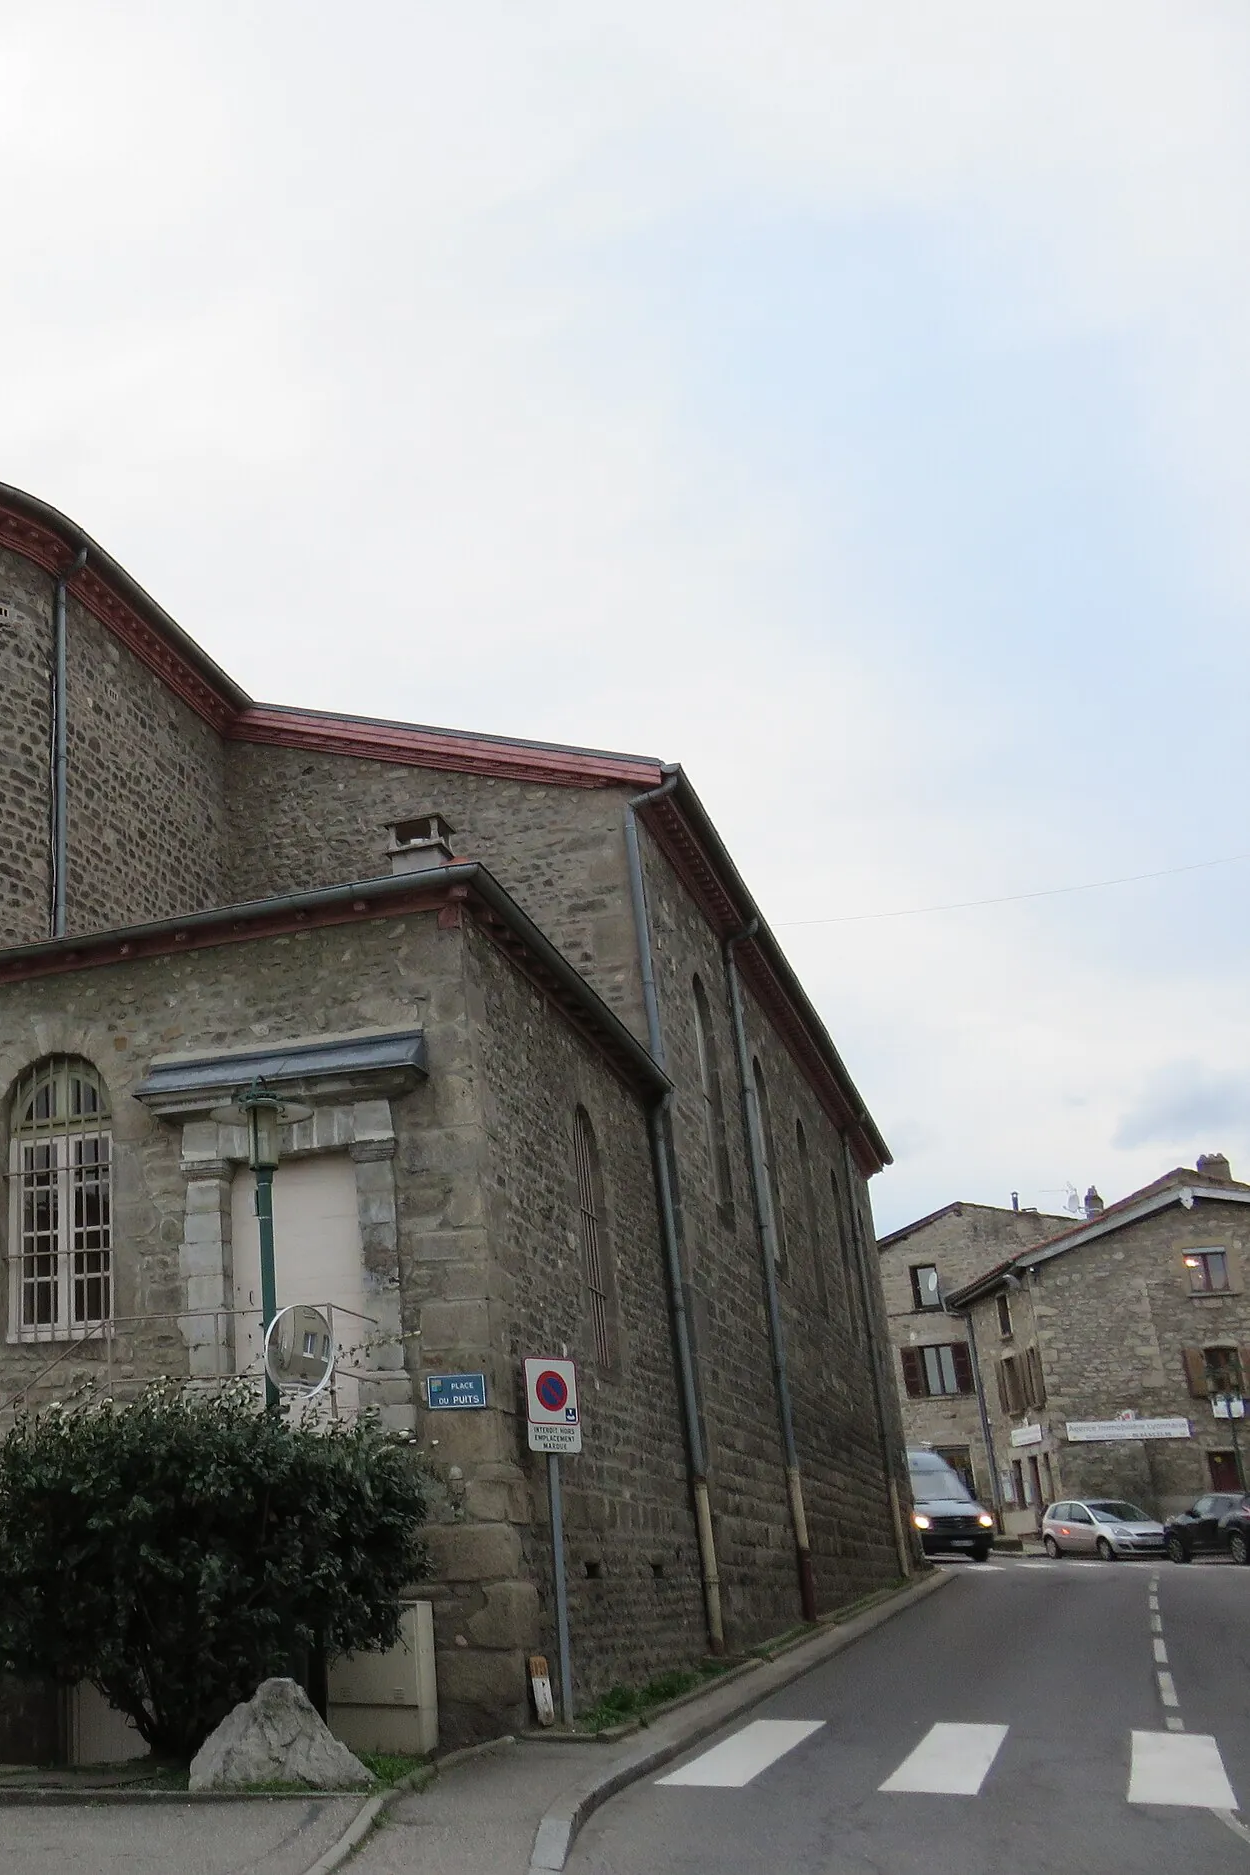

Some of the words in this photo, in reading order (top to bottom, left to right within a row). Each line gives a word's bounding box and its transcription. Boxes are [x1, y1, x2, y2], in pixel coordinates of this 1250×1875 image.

[451, 1382, 474, 1390] PLACE
[439, 1397, 449, 1405] DU
[453, 1395, 480, 1404] PUITS
[533, 1426, 558, 1434] INTERDIT
[560, 1427, 575, 1435] HORS
[534, 1434, 575, 1442] EMPLACEMENT
